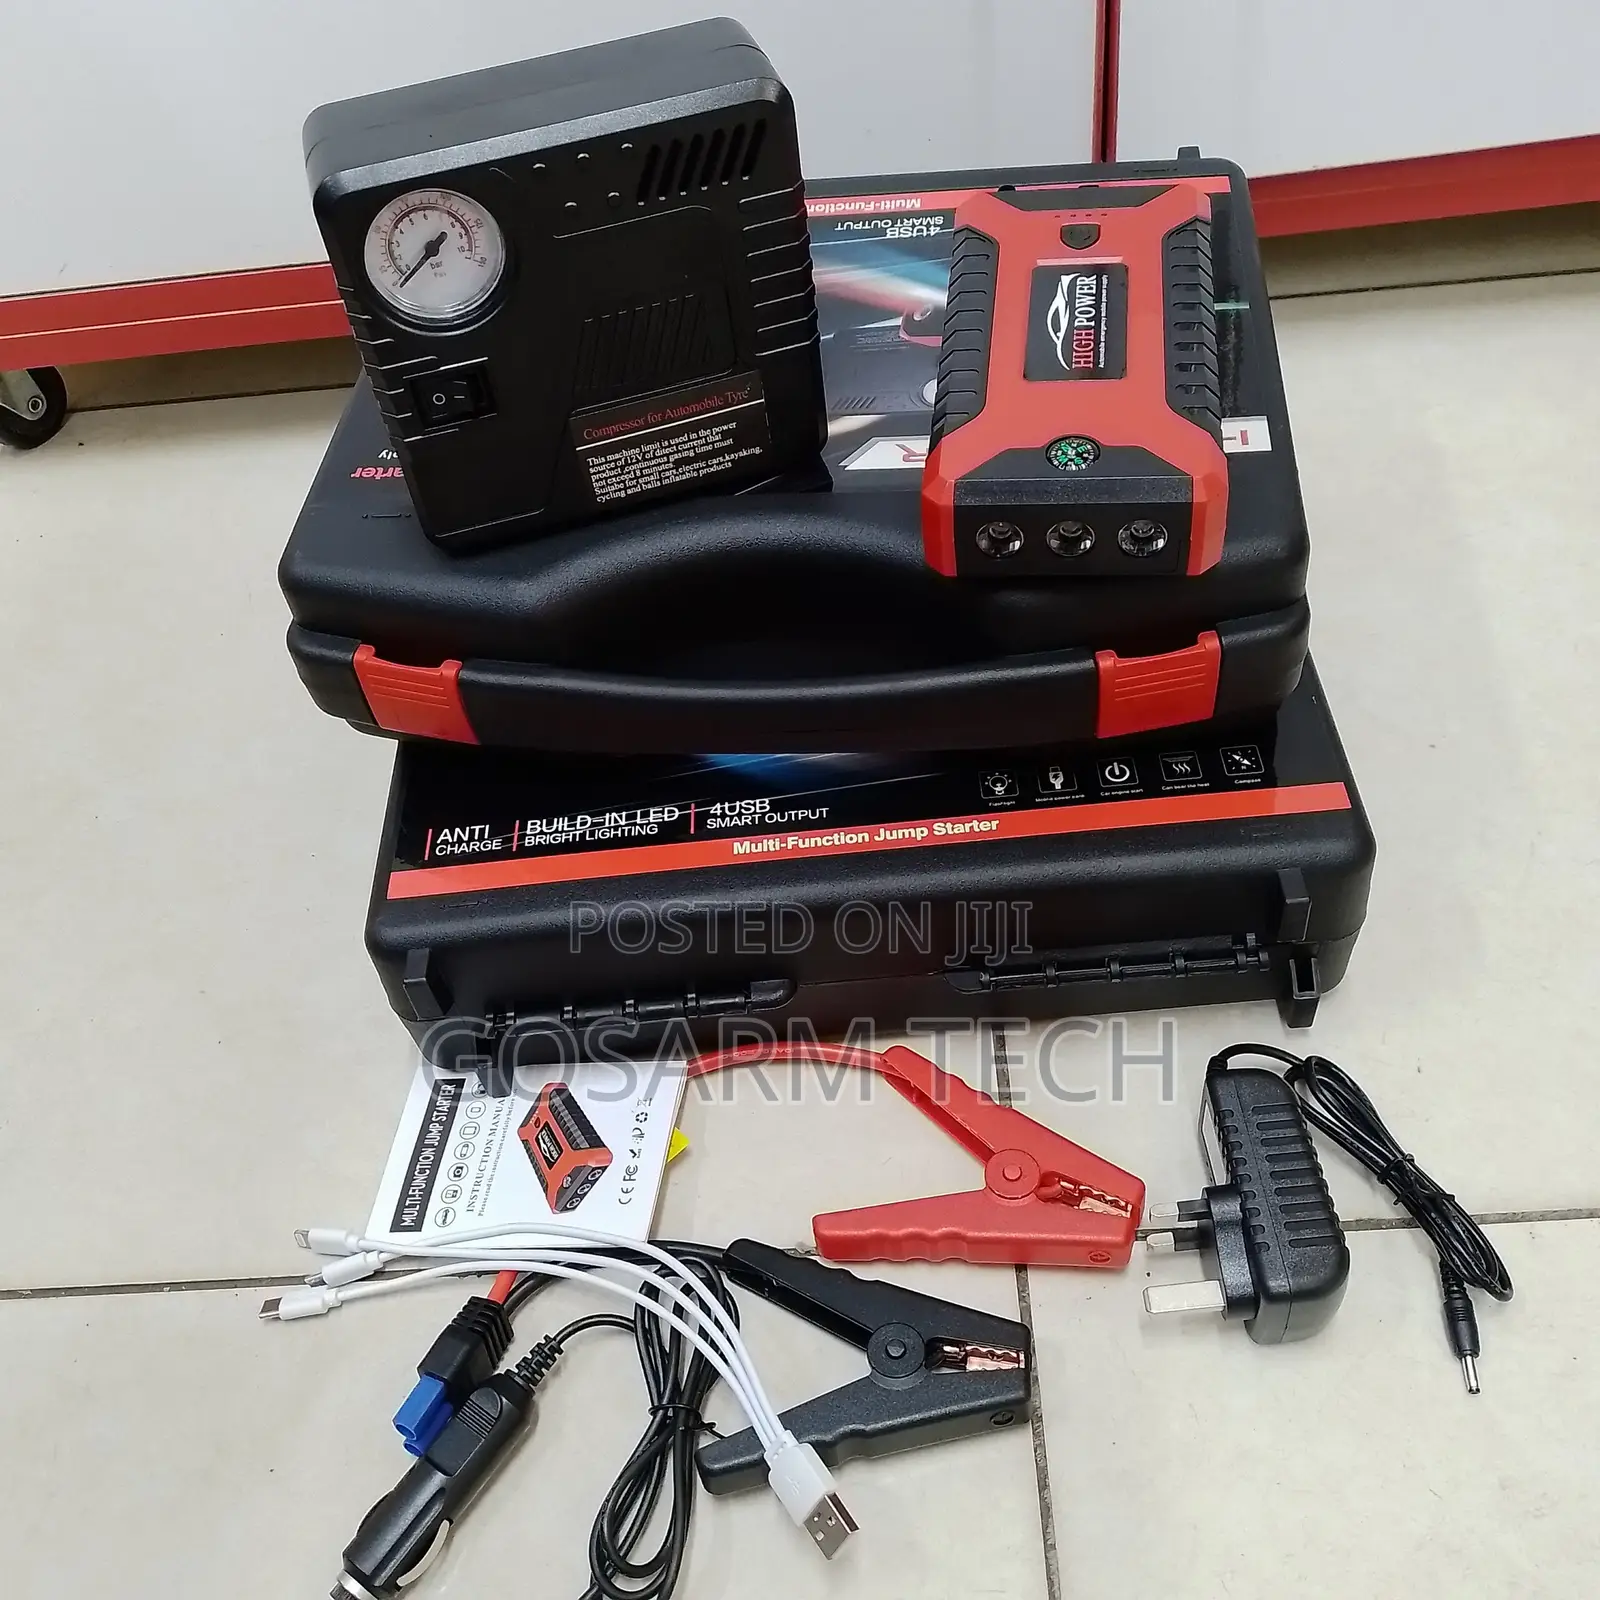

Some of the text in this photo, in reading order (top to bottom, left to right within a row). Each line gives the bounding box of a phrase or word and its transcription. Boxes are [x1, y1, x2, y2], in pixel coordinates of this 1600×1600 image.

[807, 198, 921, 213] Multi-Function
[835, 216, 944, 231] SMART OUTPUT
[886, 225, 941, 238] 4USB
[1072, 274, 1097, 368] HIGH POWER
[583, 391, 749, 440] Compressor for Automobile Tyre
[586, 421, 738, 466] This machine limit is used in the power
[589, 462, 615, 474] source
[616, 457, 626, 467] of
[626, 453, 644, 464] 12V
[645, 450, 655, 460] of
[677, 438, 706, 451] current
[706, 433, 722, 443] that
[350, 467, 404, 480] arter
[590, 468, 622, 483] product
[669, 448, 695, 463] gasing
[695, 444, 714, 455] time
[714, 438, 734, 449] must
[593, 478, 606, 488] not
[607, 471, 635, 485] exceed
[642, 462, 676, 475] minutes.
[596, 461, 733, 503] cycling and balls inflatable products
[625, 478, 638, 488] for
[638, 472, 660, 484] small
[706, 808, 830, 829] SMART OUTPUT
[709, 798, 770, 816] 4USB
[526, 806, 680, 835] BUILD-IN LED
[437, 824, 490, 844] ANTI
[524, 823, 659, 847] BRIGHT LIGHTING
[733, 818, 1000, 855] Multi-Function Jump Starter
[435, 839, 502, 856] CHARGE
[400, 1084, 457, 1226] MULTI-FUNCTION JUMP STARTER
[466, 1098, 506, 1212] INSTRUCTION MANUA
